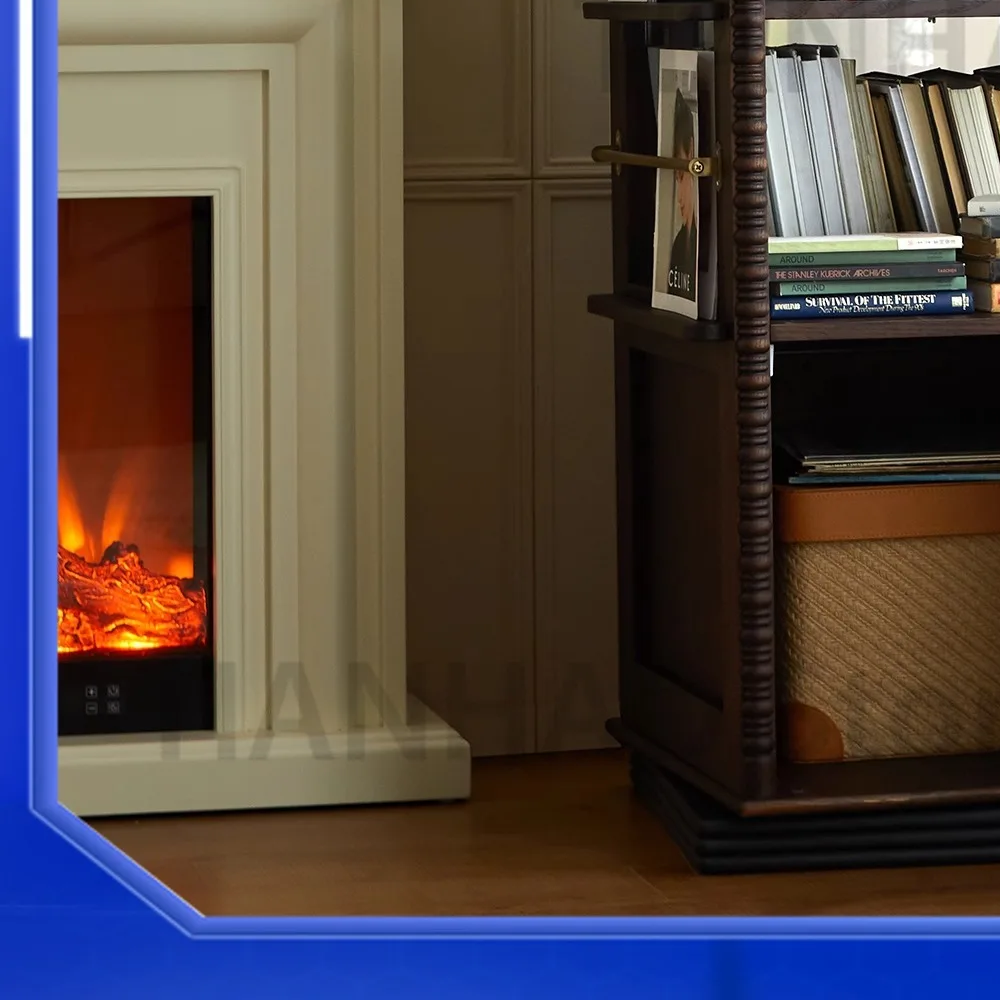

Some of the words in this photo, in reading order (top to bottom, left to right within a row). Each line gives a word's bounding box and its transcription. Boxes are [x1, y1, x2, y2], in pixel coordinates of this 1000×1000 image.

[779, 255, 815, 264] AROUND
[774, 271, 787, 279] THE
[787, 270, 819, 279] STANLEY
[820, 269, 850, 278] KUBRICK
[852, 268, 891, 278] ARCHIVES
[668, 266, 691, 292] CÉLINE
[791, 283, 826, 293] AROUND
[805, 296, 854, 308] SURVIVAL
[855, 295, 870, 306] OF
[871, 295, 894, 305] THE
[895, 294, 937, 304] FITTEST
[832, 305, 852, 313] Product
[853, 304, 885, 312] Development
